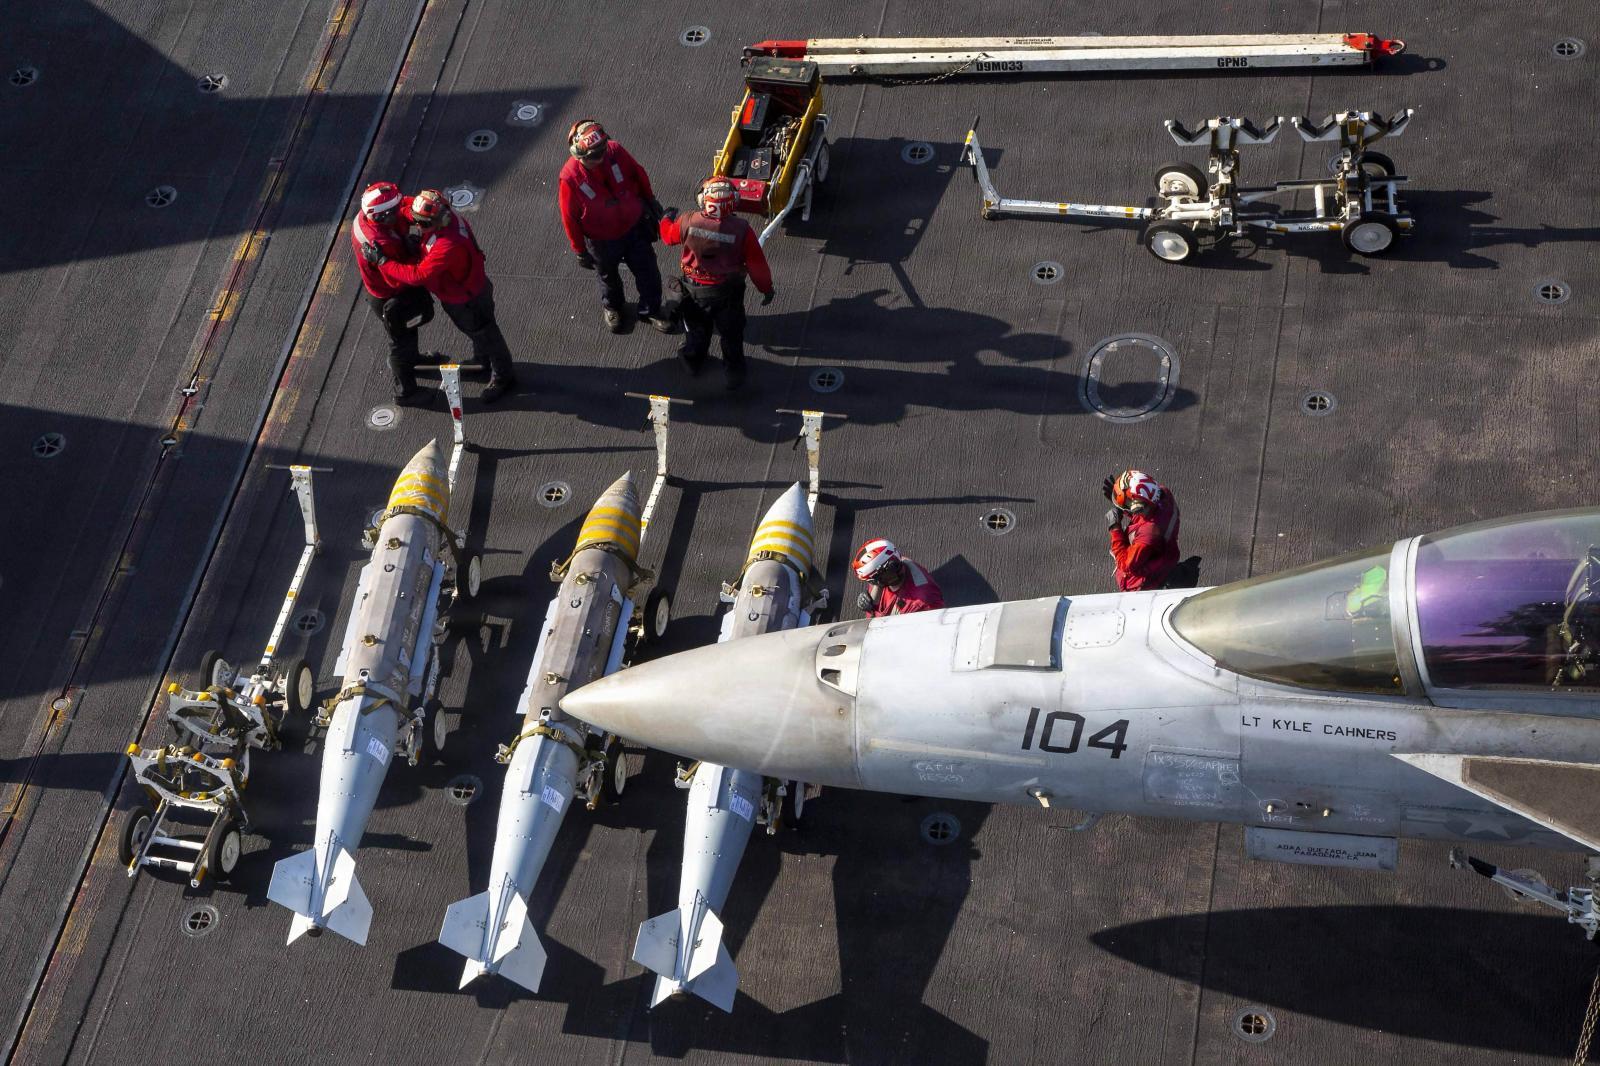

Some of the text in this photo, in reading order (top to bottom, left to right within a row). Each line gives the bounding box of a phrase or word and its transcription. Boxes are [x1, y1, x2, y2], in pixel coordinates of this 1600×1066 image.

[1021, 707, 1130, 760] 104
[1242, 715, 1397, 741] LT KYLE CAHNERS
